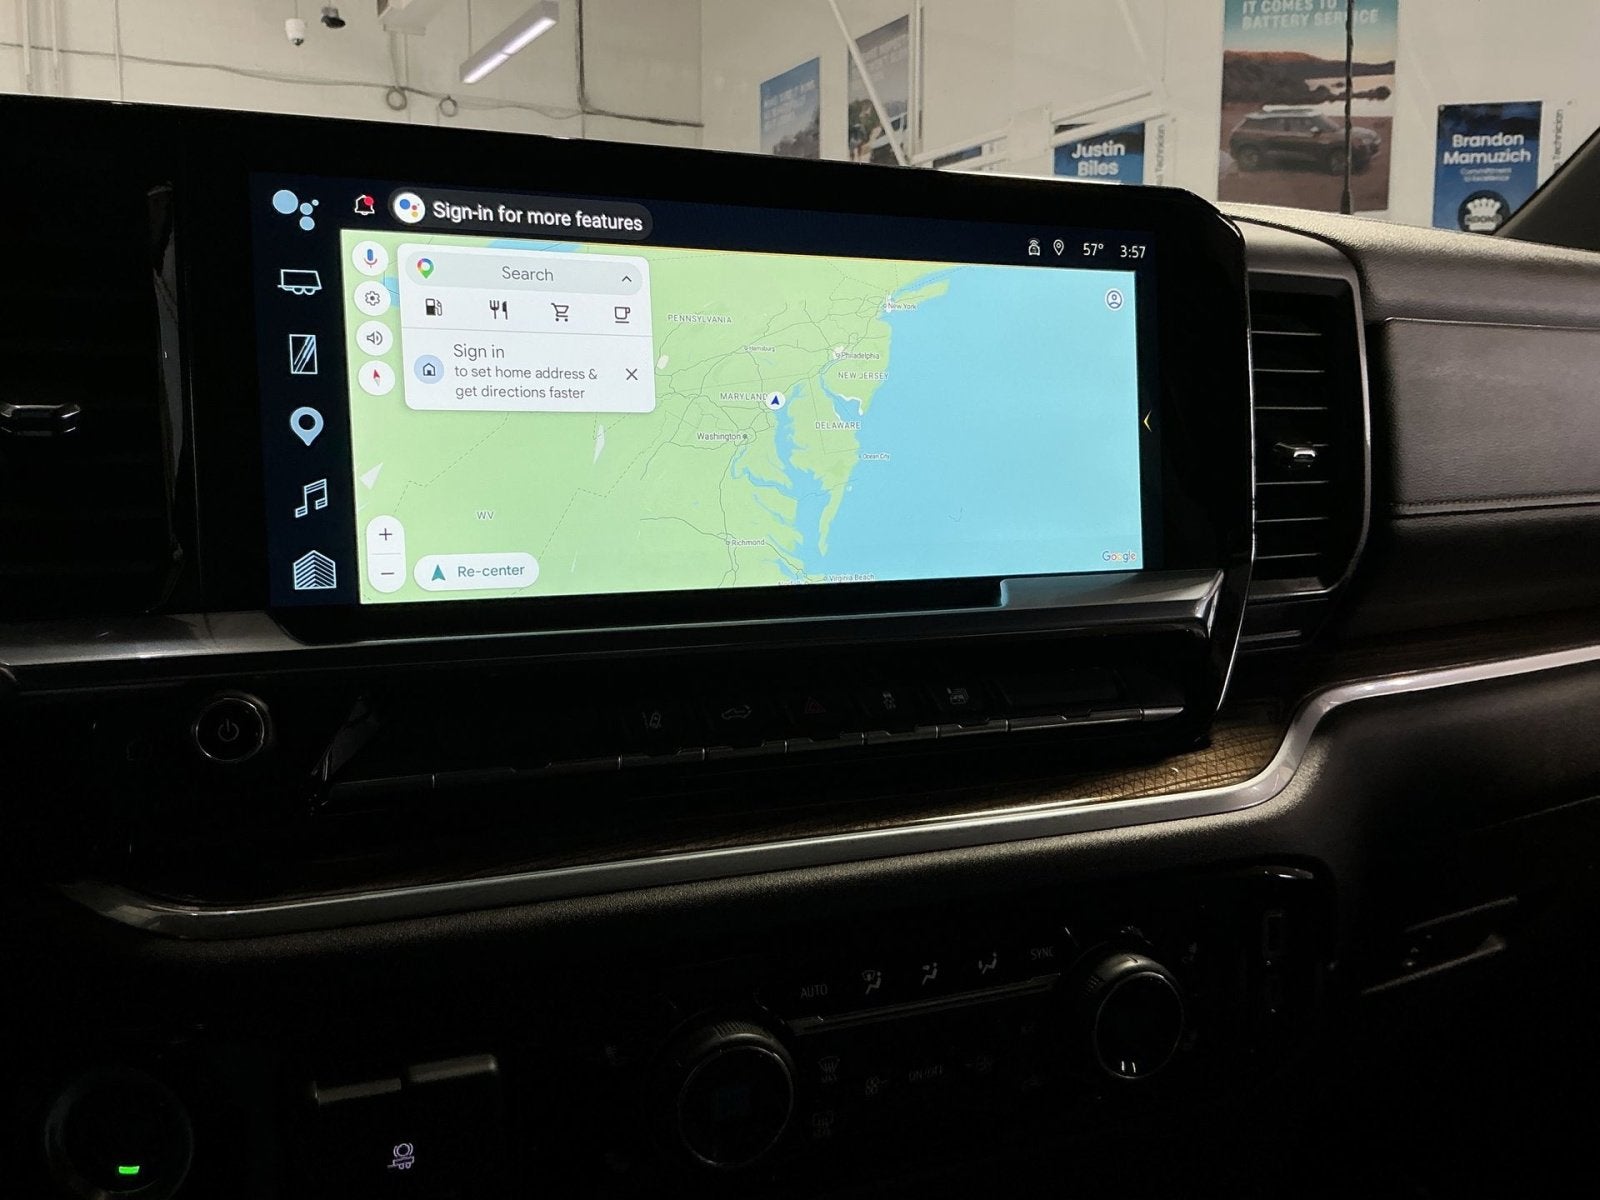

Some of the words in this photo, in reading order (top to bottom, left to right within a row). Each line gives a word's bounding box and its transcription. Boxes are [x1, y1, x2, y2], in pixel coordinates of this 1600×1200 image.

[1260, 0, 1314, 13] COMES
[1242, 12, 1310, 30] BATTERY
[1452, 132, 1525, 148] Brandon
[1071, 140, 1126, 159] Justin
[1443, 148, 1532, 165] Mamuzich
[1077, 160, 1119, 177] Biles
[432, 201, 494, 224] Sign-in
[498, 205, 524, 224] for
[527, 210, 572, 227] more
[575, 210, 644, 232] features
[1120, 244, 1146, 259] 3:57
[501, 265, 554, 282] Search
[903, 302, 917, 310] York
[667, 313, 733, 324] PENNSYLVANIA
[453, 343, 487, 362] Sign
[491, 344, 505, 359] in
[841, 351, 880, 361] Philadelphia
[454, 365, 468, 378] to
[471, 366, 492, 378] set
[495, 365, 532, 379] home
[535, 367, 586, 380] address
[588, 368, 598, 380] &
[838, 371, 857, 379] NEW
[859, 372, 889, 380] JERSEY
[455, 386, 477, 400] get
[481, 385, 546, 399] directions
[549, 386, 586, 399] faster
[720, 392, 768, 401] MARYLAND
[815, 421, 861, 430] DELAWARE
[697, 432, 742, 442] Washington
[476, 511, 494, 520] WV
[731, 538, 765, 547] Richmond
[1102, 550, 1136, 563] Google
[457, 564, 525, 578] Re-center
[830, 574, 854, 583] Virginia
[855, 573, 875, 582] Beach
[1030, 945, 1055, 960] SYNC
[800, 984, 828, 999] AUTO
